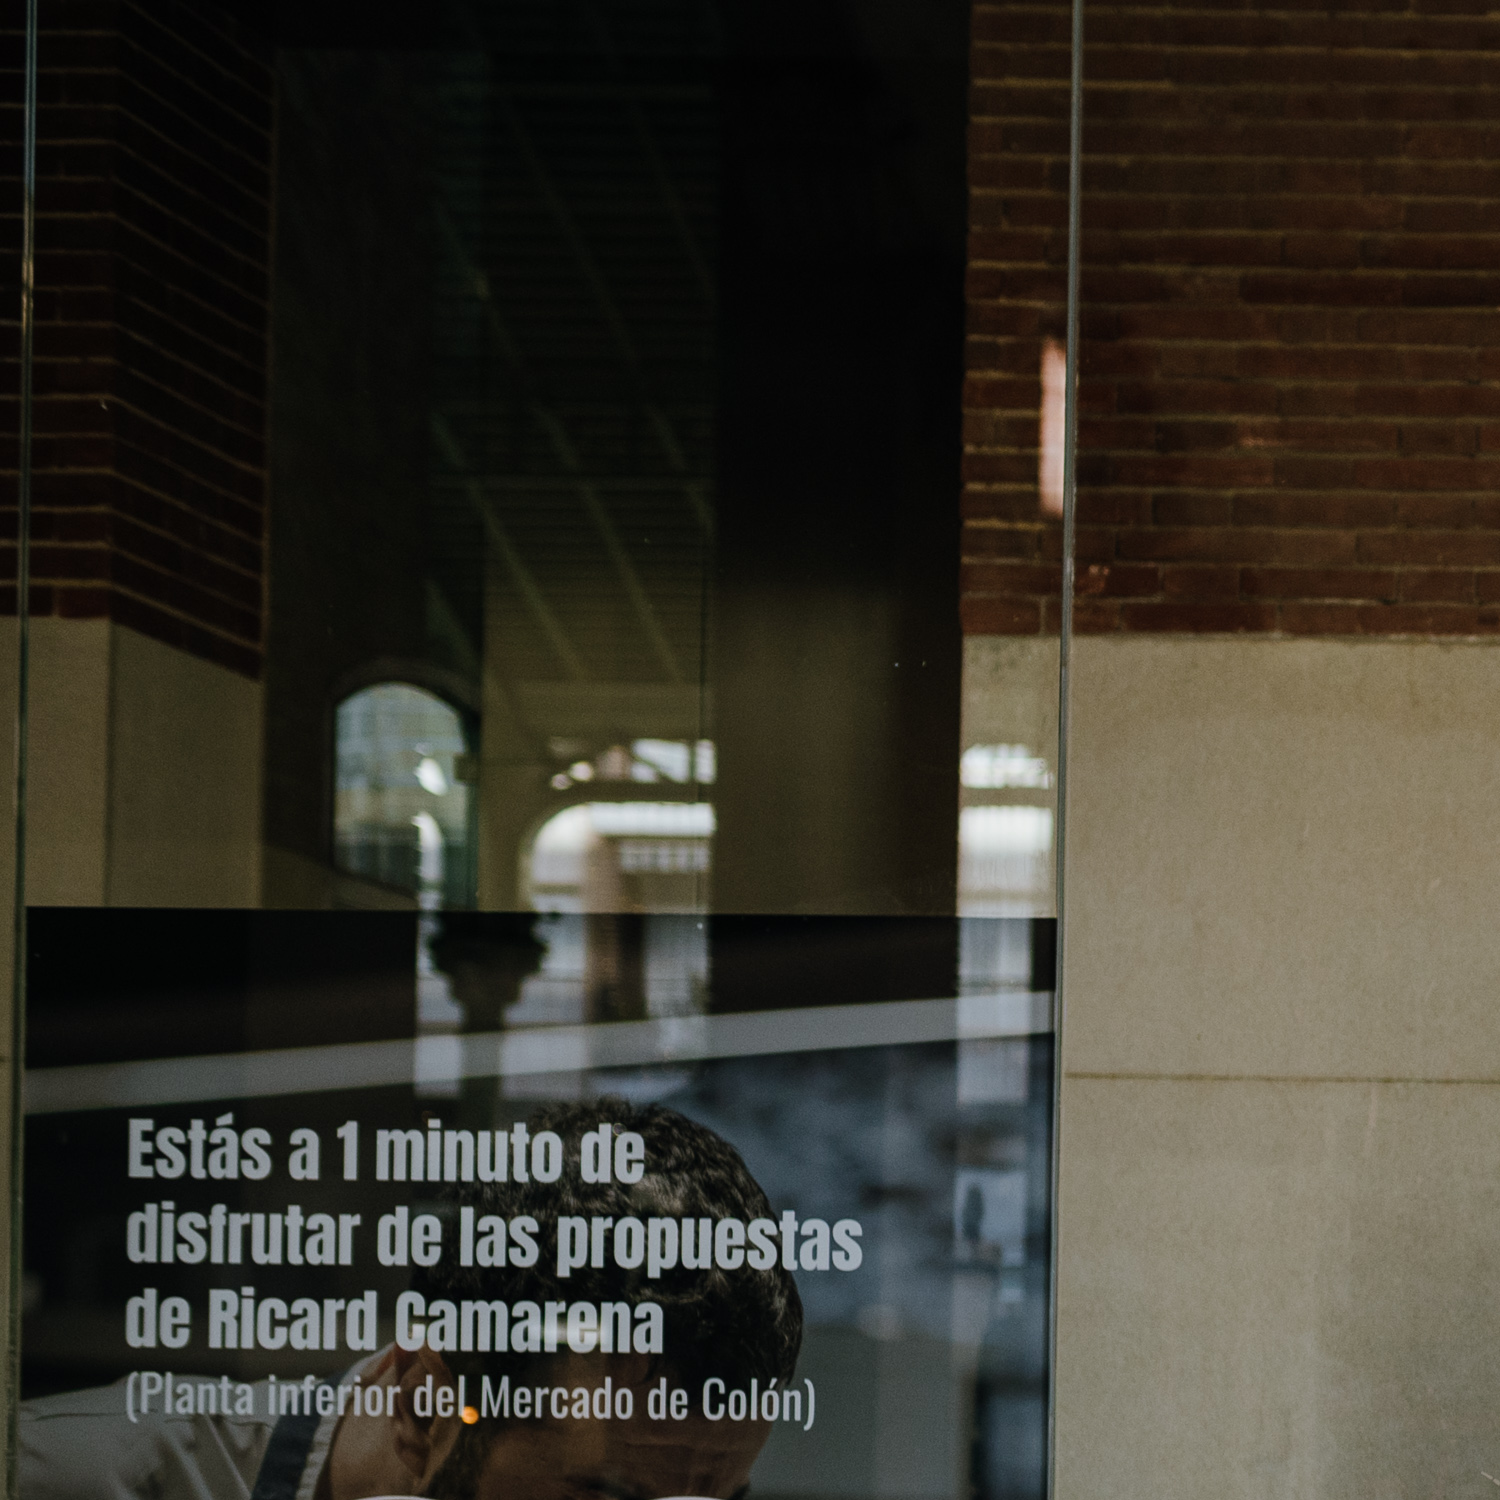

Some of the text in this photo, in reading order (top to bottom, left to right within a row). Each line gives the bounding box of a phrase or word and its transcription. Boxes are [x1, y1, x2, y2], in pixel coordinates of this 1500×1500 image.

[129, 1113, 645, 1183] Estás a 1 minuto de
[127, 1198, 862, 1278] disfrutar de las propuestas
[126, 1287, 664, 1355] de Ricard Camarena
[125, 1371, 815, 1431] (Planta inferior del Mercado de Colón)
